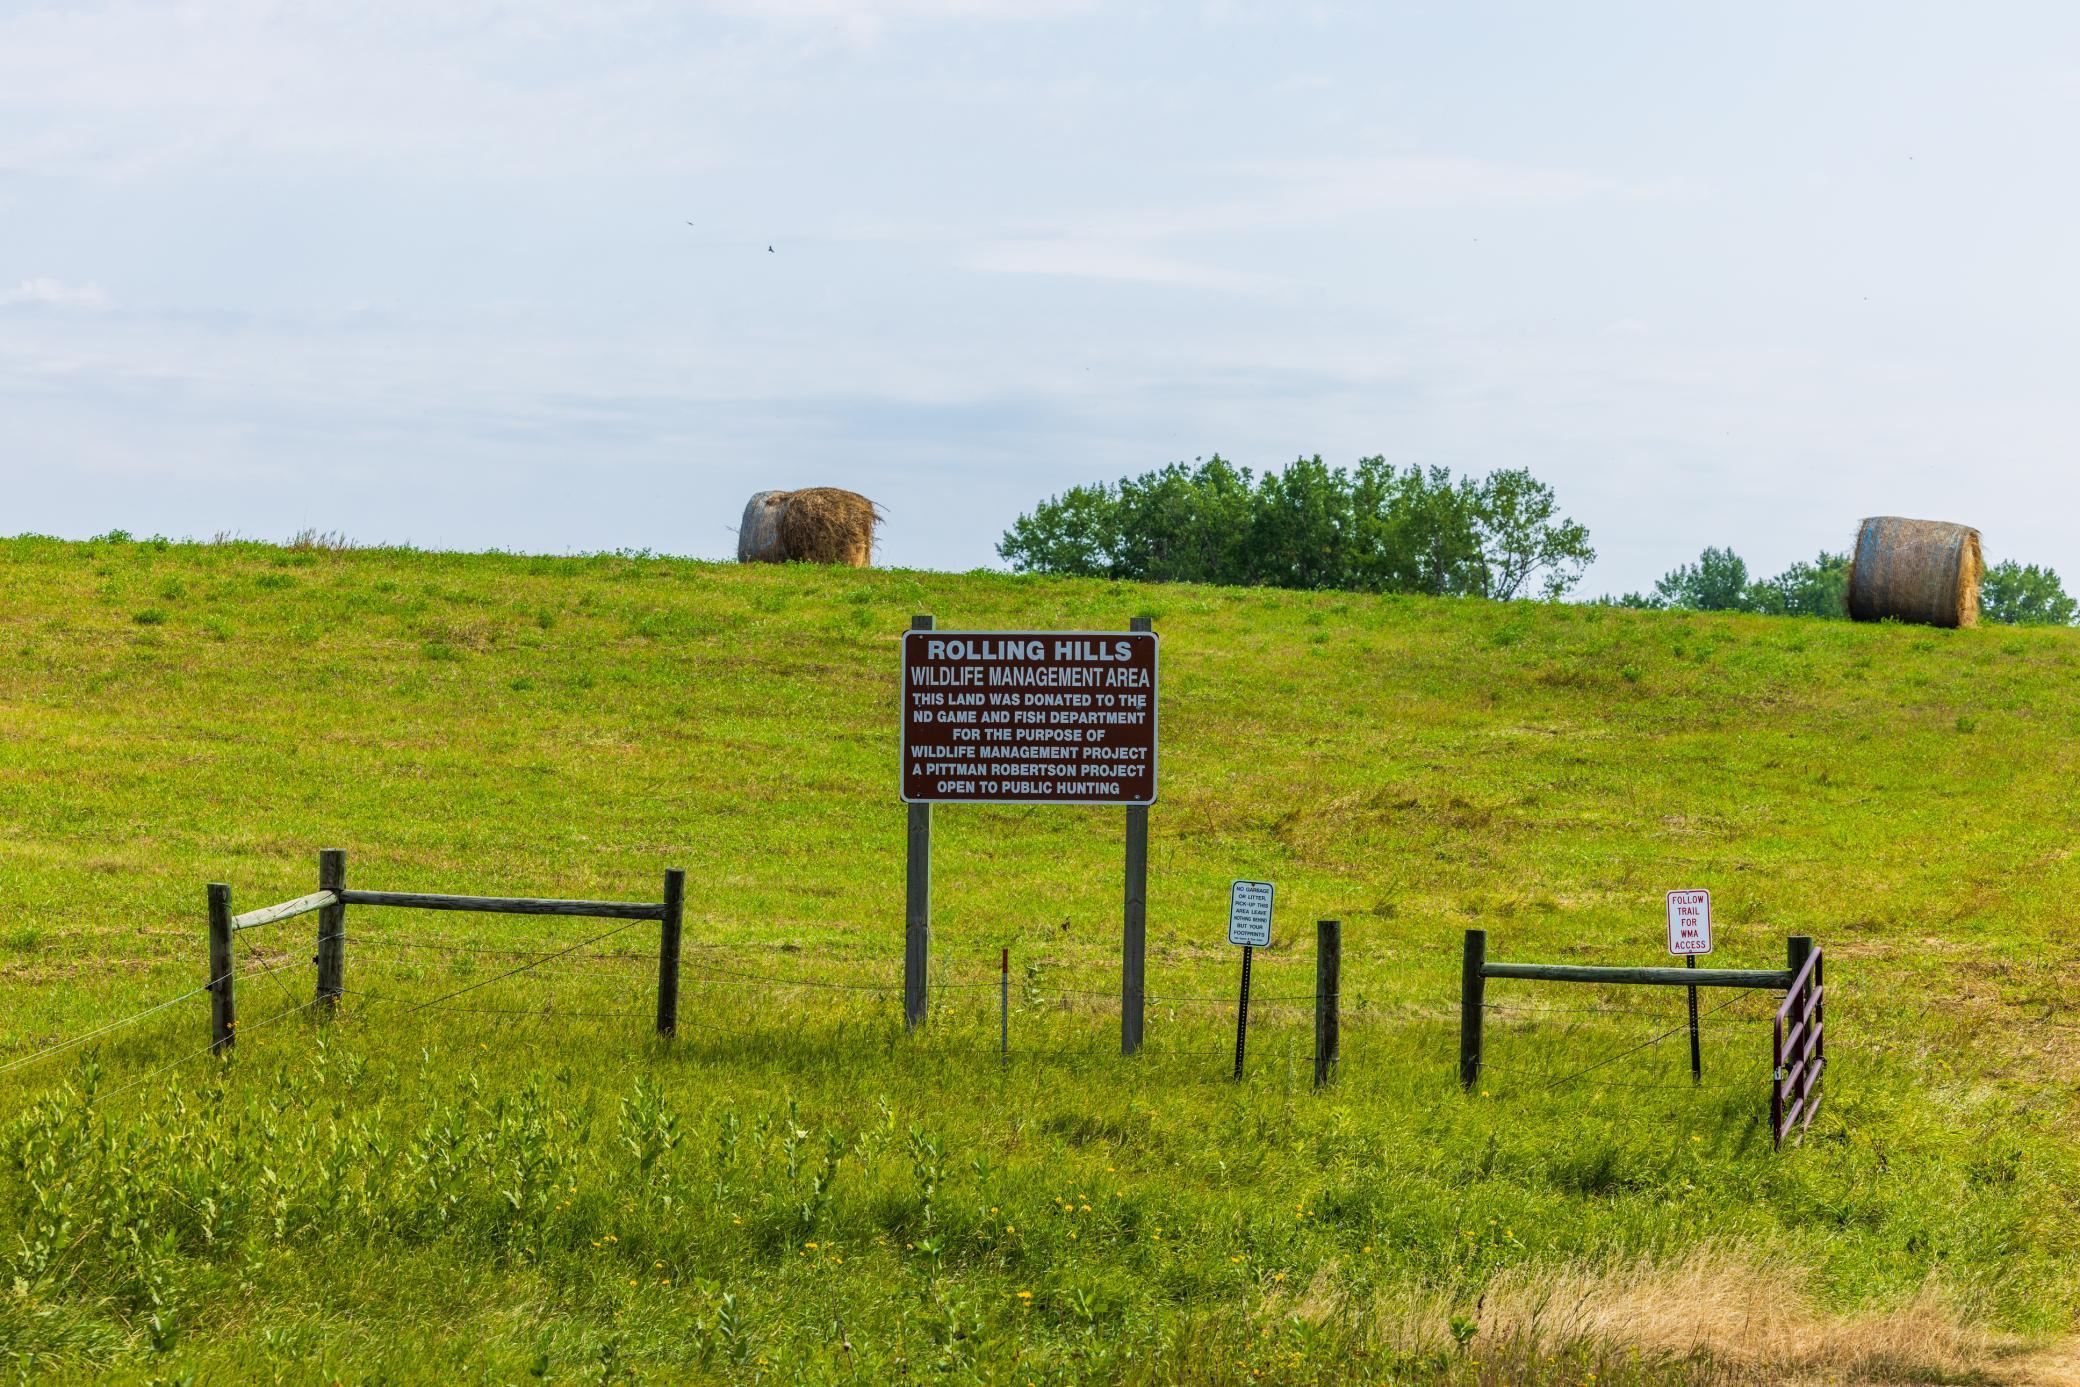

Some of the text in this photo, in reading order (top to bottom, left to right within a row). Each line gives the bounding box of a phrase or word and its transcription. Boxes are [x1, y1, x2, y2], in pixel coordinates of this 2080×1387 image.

[928, 640, 1132, 661] ROLLING HILLS
[911, 666, 1150, 687] WILDLIFE MANAGEMENT AREA
[913, 693, 1146, 707] THIS LAND WAS DONATED TO THE
[913, 711, 1145, 724] ND GAME AND FISH DEPARTMENT
[953, 728, 1105, 742] FOR THE PURPOSE OF
[911, 746, 1147, 760] WILDLIFE MANAGEMENT PROJECT
[913, 763, 1145, 777] A PITTMAN ROBERTSON PROJECT
[937, 781, 1119, 794] OPEN TO PUBLIC HUNTING
[1672, 896, 1703, 904] FOLLOW
[1677, 907, 1699, 915] TRAIL
[1681, 930, 1698, 938] WMA
[1675, 941, 1706, 949] ACCESS
